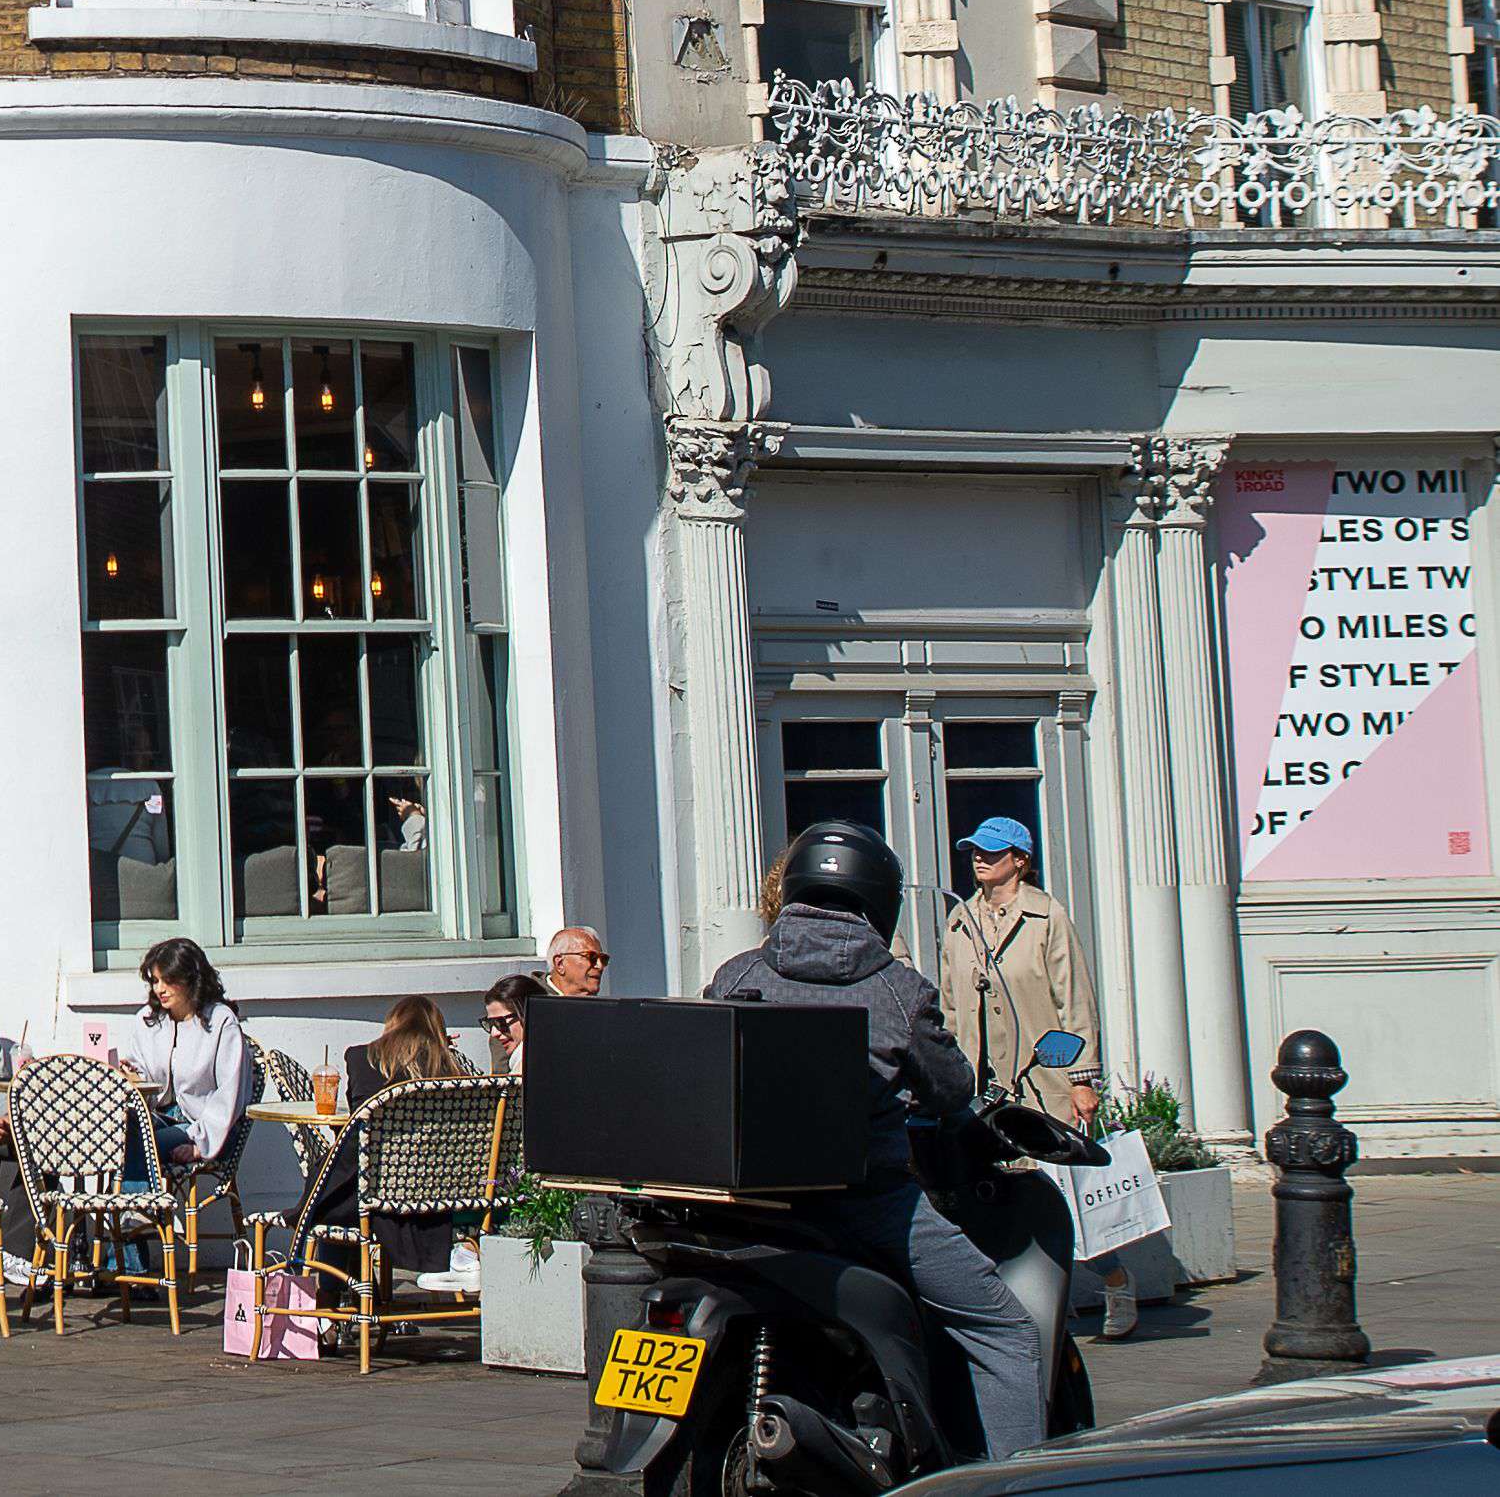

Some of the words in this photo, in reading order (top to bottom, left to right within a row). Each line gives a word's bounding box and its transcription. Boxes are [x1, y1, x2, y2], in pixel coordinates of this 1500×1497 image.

[1332, 470, 1406, 494] TWO
[1319, 518, 1384, 542] LES
[1395, 517, 1439, 542] OF
[1417, 565, 1471, 589] TW
[1300, 616, 1326, 639] O
[1338, 614, 1448, 639] MILES
[1289, 665, 1308, 688] F
[1320, 663, 1430, 687] STYLE
[1274, 712, 1350, 737] TWO
[1263, 761, 1330, 786] LES
[1085, 1175, 1141, 1206] OFFICE
[611, 1334, 698, 1372] LD22
[618, 1369, 678, 1402] TKC
